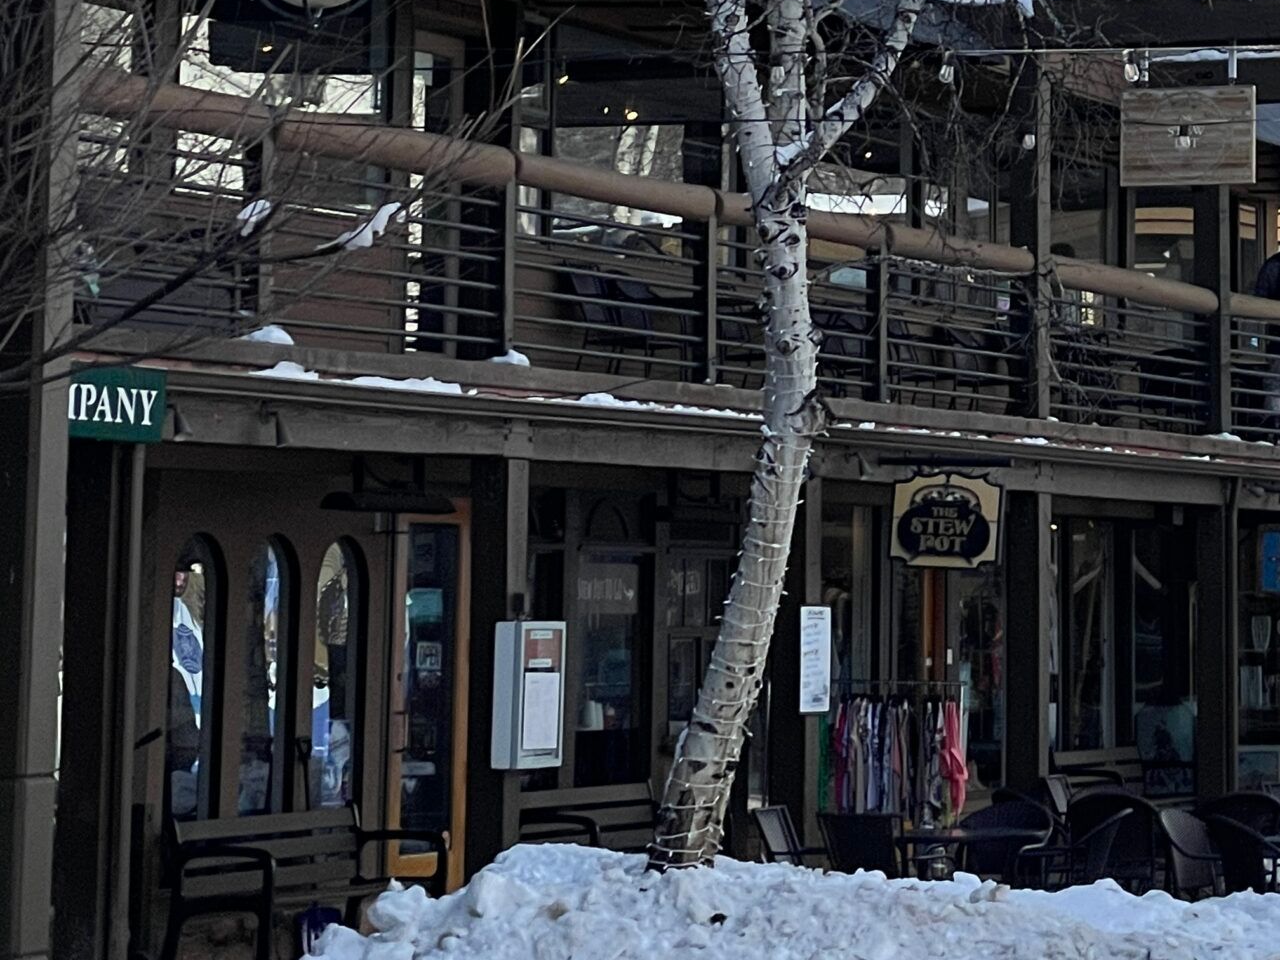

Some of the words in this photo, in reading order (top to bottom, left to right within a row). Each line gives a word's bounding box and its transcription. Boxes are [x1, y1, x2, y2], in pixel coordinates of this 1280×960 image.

[931, 506, 958, 519] THE
[910, 512, 977, 536] STEW
[918, 534, 967, 553] POT
